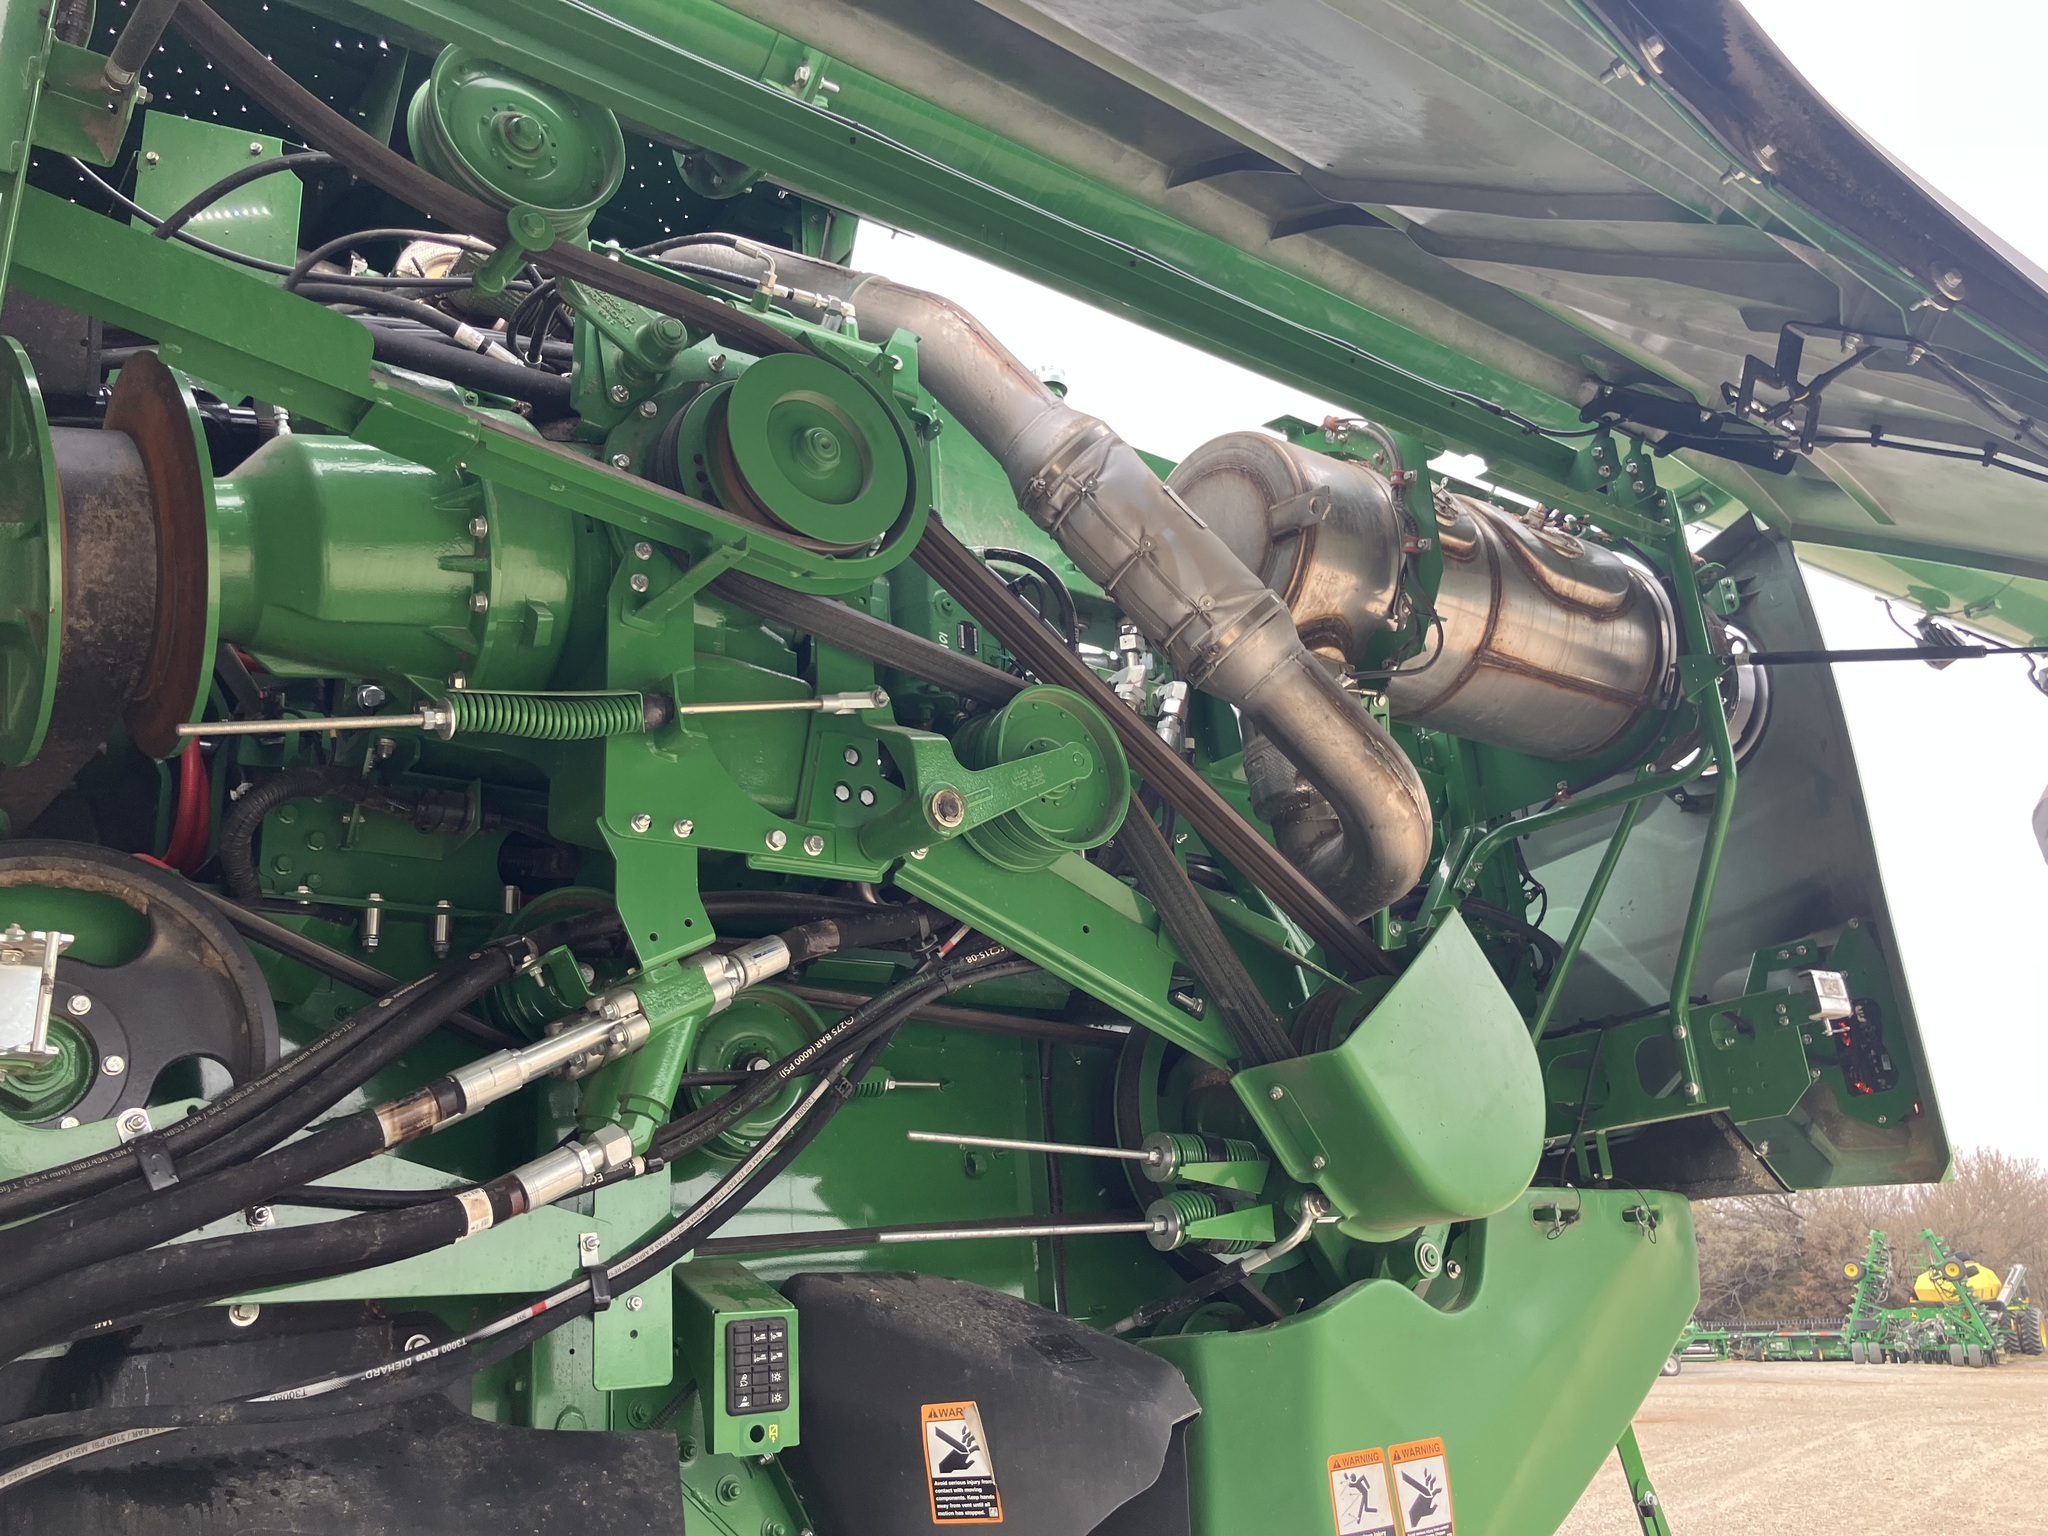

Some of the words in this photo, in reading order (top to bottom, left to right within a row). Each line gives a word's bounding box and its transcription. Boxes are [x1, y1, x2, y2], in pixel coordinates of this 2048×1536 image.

[831, 1022, 847, 1036] 275
[814, 1033, 832, 1049] BAR
[794, 1045, 816, 1066] (4000
[208, 1104, 224, 1116] SAE
[256, 1072, 279, 1088] Flame
[277, 1051, 311, 1073] Resistant
[310, 1038, 332, 1054] MSHA
[779, 1064, 796, 1079] PSI)
[794, 1096, 816, 1120] T3008D
[726, 1179, 738, 1191] BAR
[689, 1209, 705, 1223] MSHA
[622, 1250, 650, 1270] ABRASION
[441, 1337, 468, 1354] T3000
[938, 1407, 965, 1418] WAR
[107, 1434, 126, 1446] 3100
[132, 1428, 150, 1438] BAR
[91, 1439, 106, 1450] PSI
[1401, 1442, 1441, 1458] WARNING
[66, 1446, 88, 1460] MSHA
[1341, 1452, 1380, 1467] WARNING
